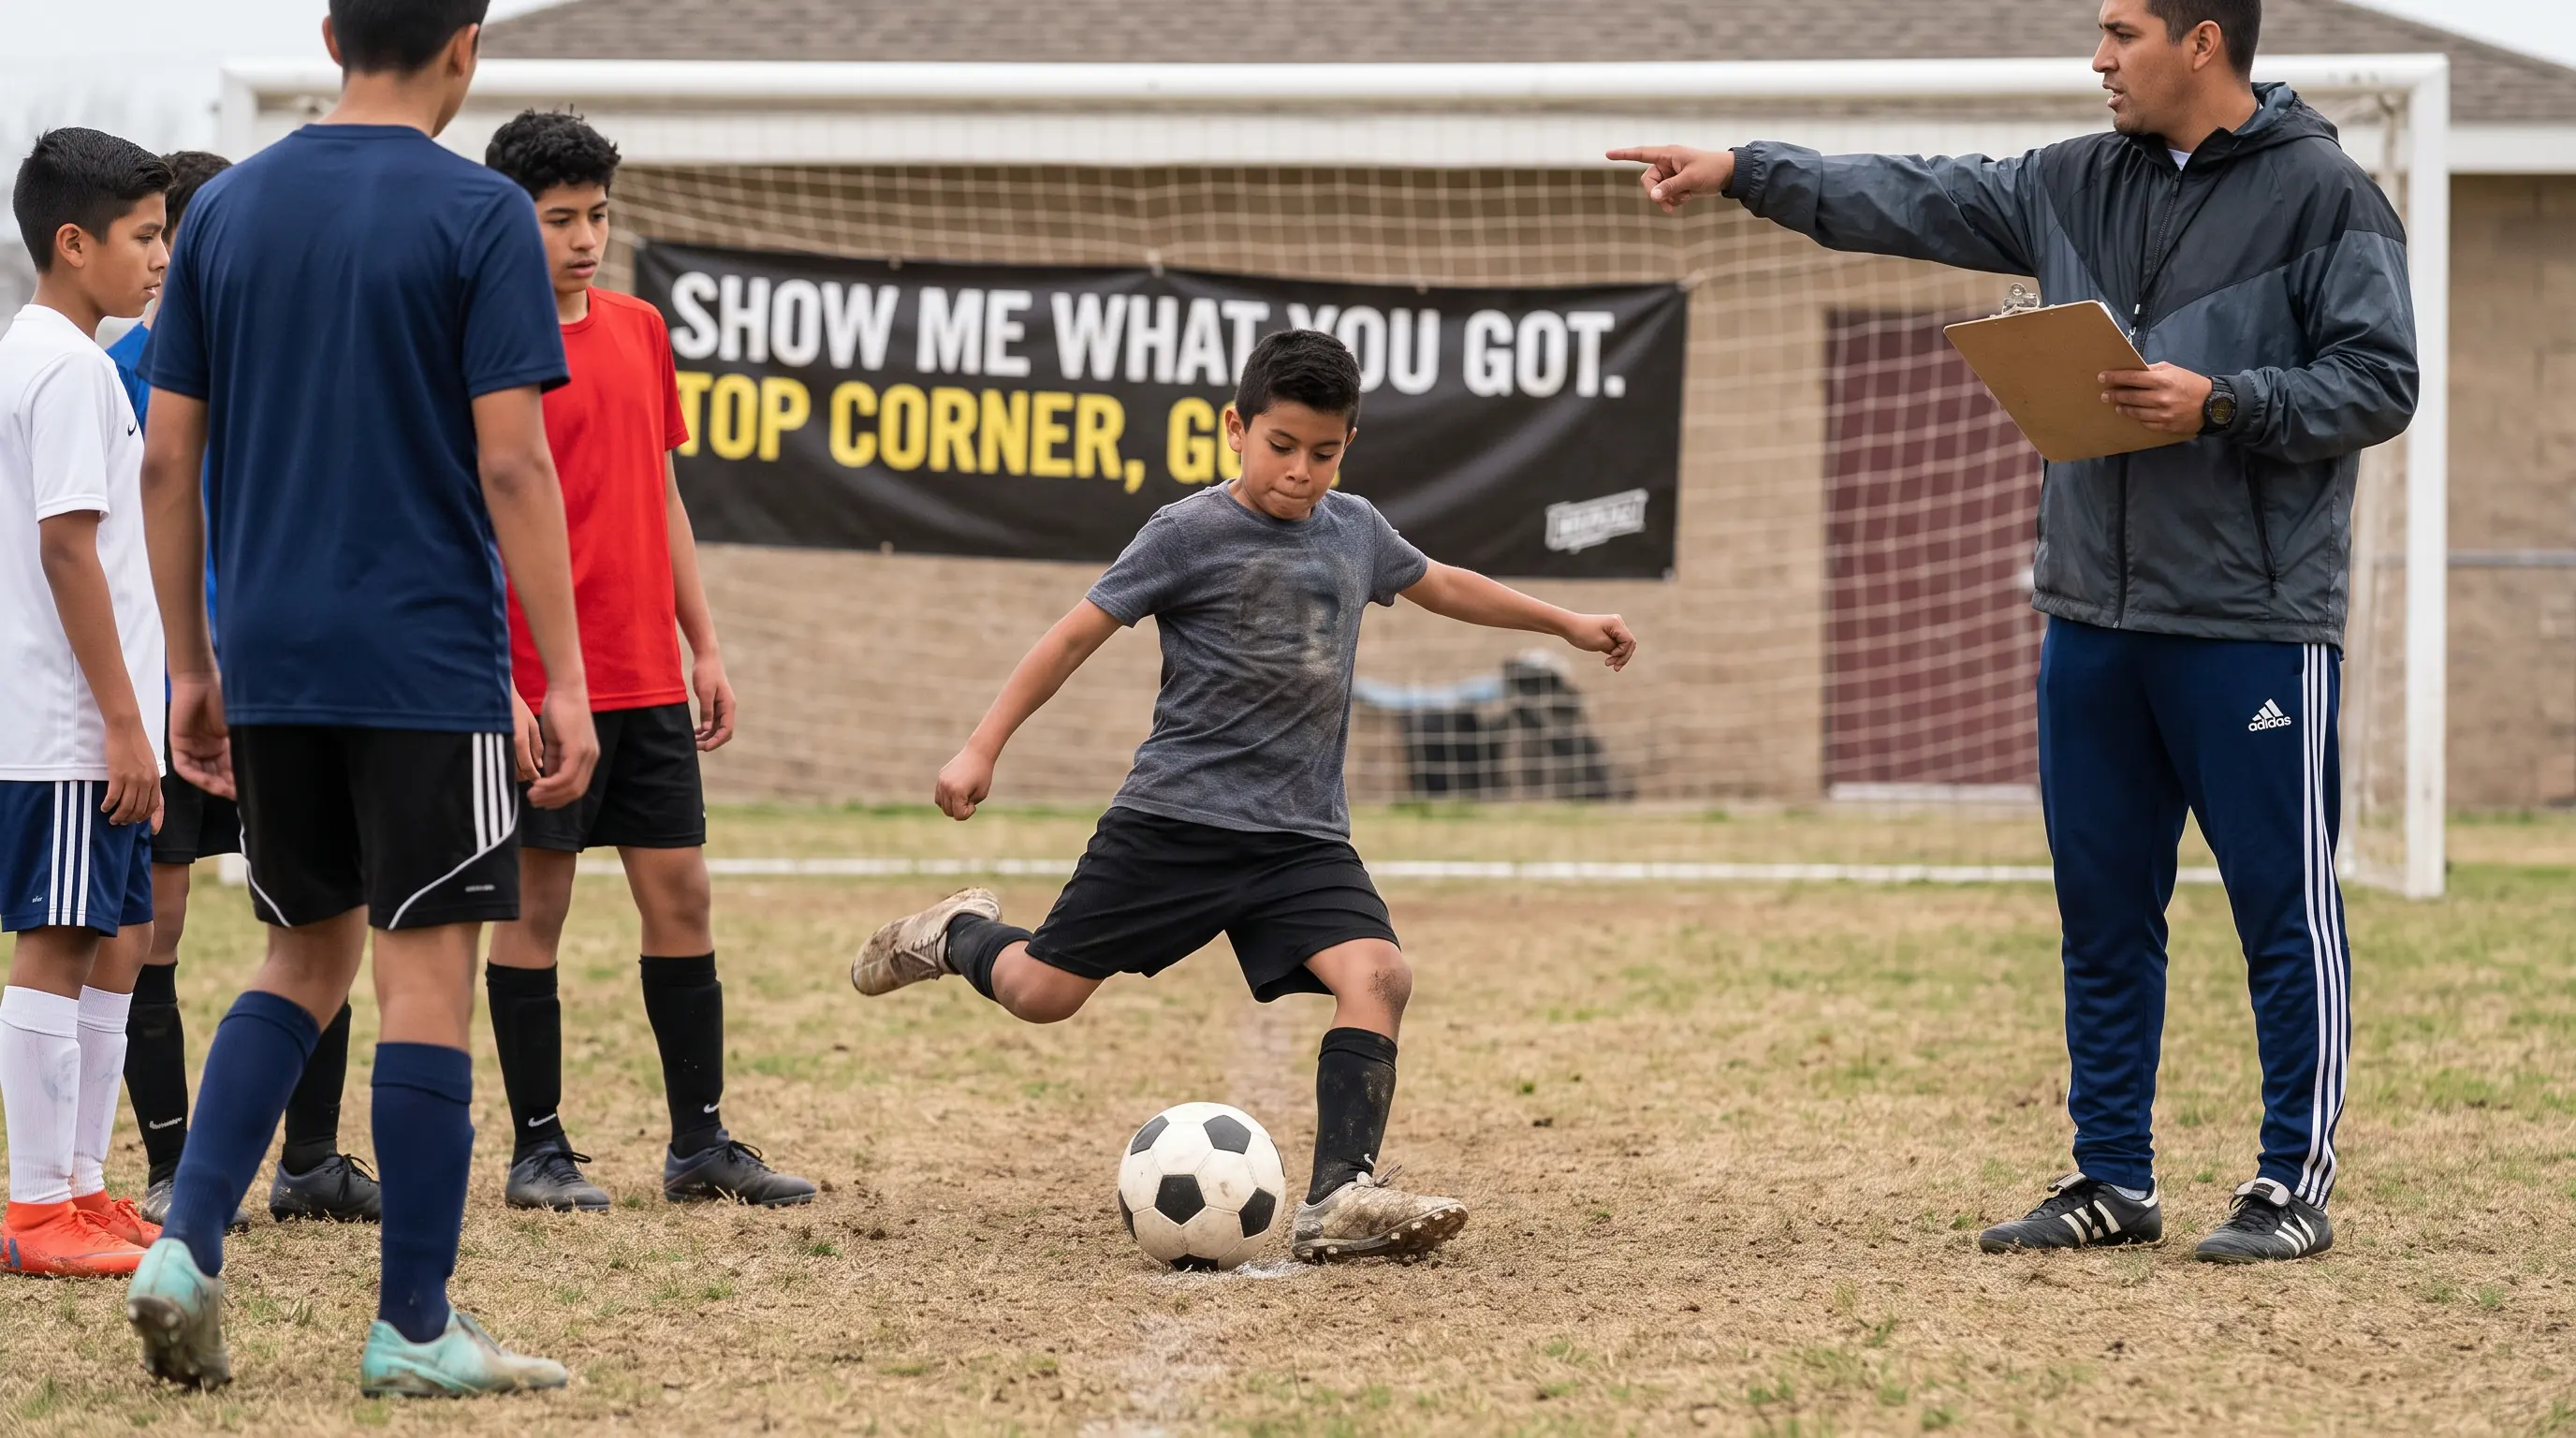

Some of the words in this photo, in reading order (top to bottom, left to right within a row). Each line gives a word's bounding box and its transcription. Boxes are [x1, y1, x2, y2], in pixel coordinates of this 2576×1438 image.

[670, 271, 900, 371] SHOW
[916, 286, 1033, 377] ME
[1050, 291, 1272, 386] WHAT
[1463, 309, 1626, 398] GOT.
[675, 370, 812, 462] TOP
[828, 380, 1146, 494] CORNER,
[2248, 716, 2291, 731] adidas
